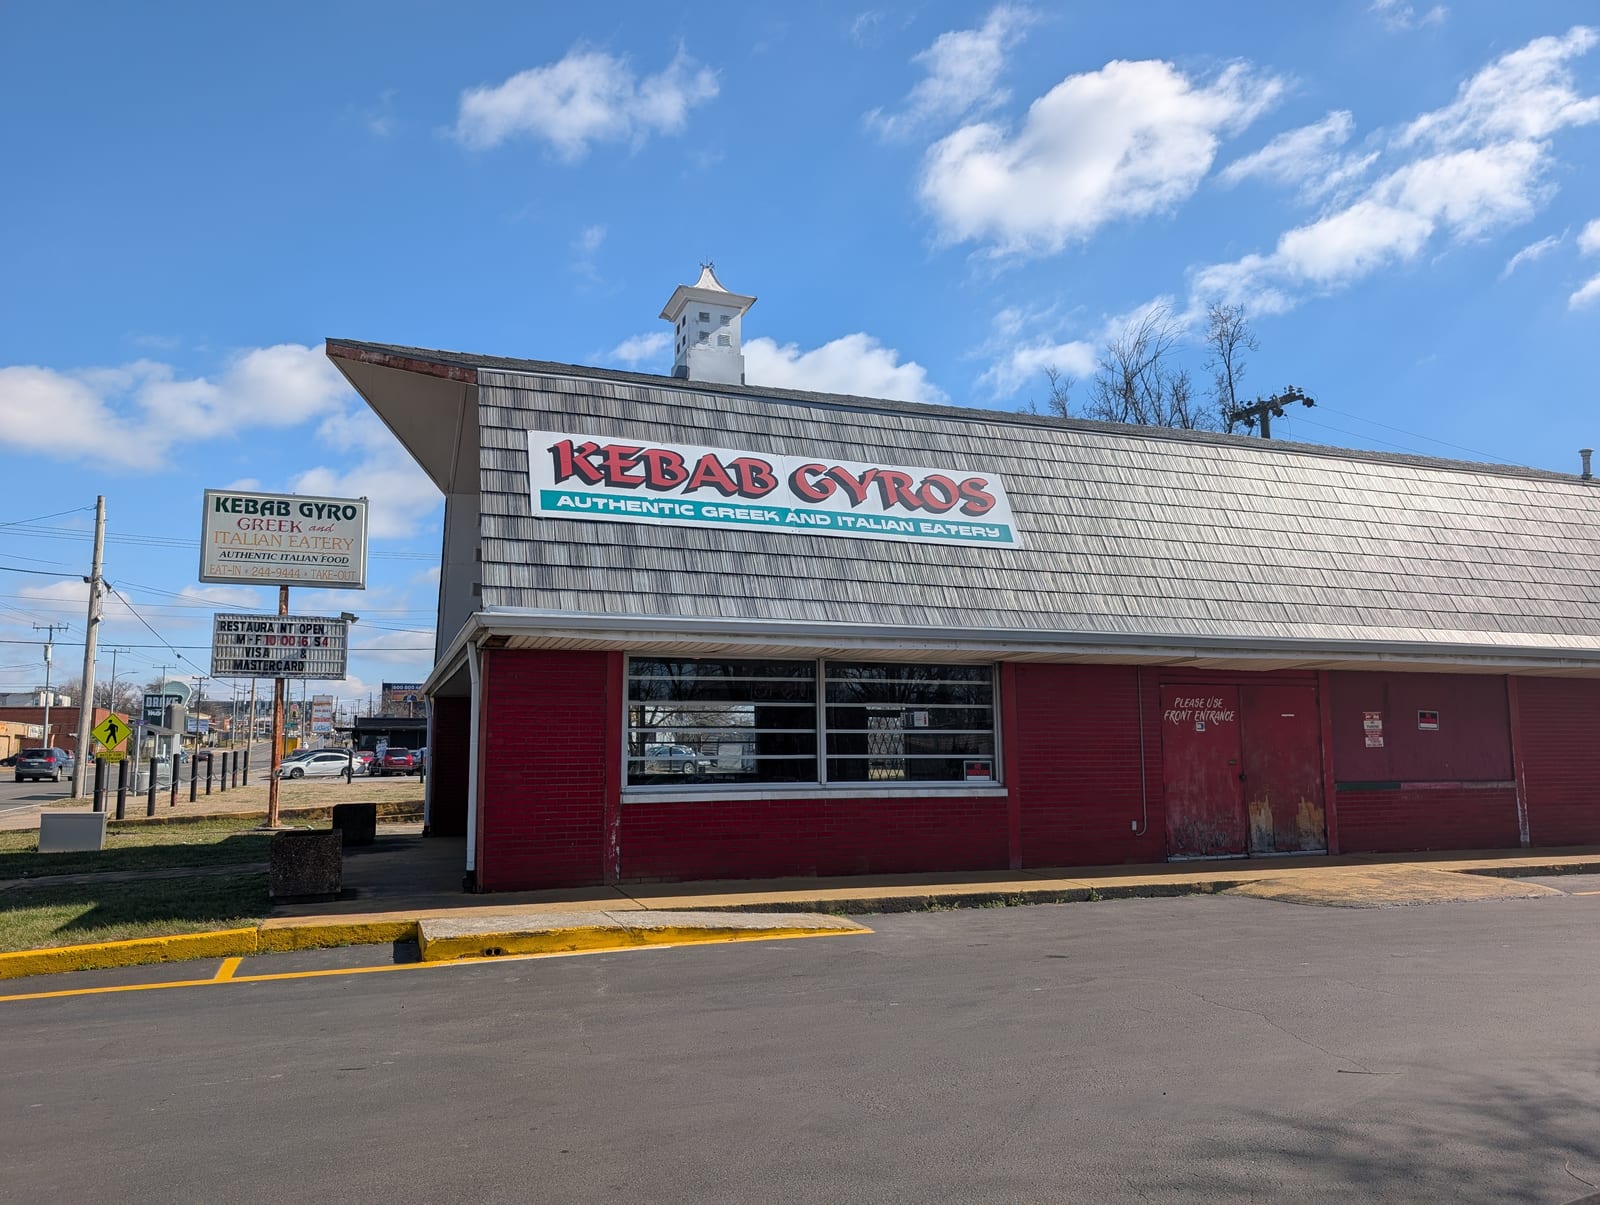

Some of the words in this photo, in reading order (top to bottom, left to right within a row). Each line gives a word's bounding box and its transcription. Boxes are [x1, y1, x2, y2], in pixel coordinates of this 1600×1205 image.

[547, 439, 779, 499] KEBAB
[788, 463, 996, 517] GYROS
[215, 497, 291, 517] KEBAB
[299, 503, 357, 522] GYRO
[557, 495, 695, 516] AUTHENTIC
[701, 506, 780, 522] GREEK
[785, 513, 832, 525] AND
[838, 516, 915, 533] ITALIAN
[920, 522, 1000, 538] EATERY
[237, 517, 303, 534] GREEK
[308, 523, 335, 533] and
[214, 530, 282, 548] ITALIAN
[288, 535, 354, 551] EATERY
[219, 550, 279, 561] AUTHENTIC
[280, 553, 319, 563] ITALIAN
[320, 556, 349, 564] FOOD
[209, 564, 241, 576] EAT-IN
[251, 566, 300, 578] 244-9444
[311, 570, 356, 581] TAKE-OUT
[300, 624, 325, 634] OPEN
[245, 647, 270, 658] VISA
[300, 649, 307, 659] &
[233, 660, 305, 671] MASTERCARD
[1174, 697, 1205, 708] PLEASE
[1206, 696, 1224, 708] USE
[1164, 709, 1193, 725] FRONT
[1194, 708, 1235, 725] ENTRANCE
